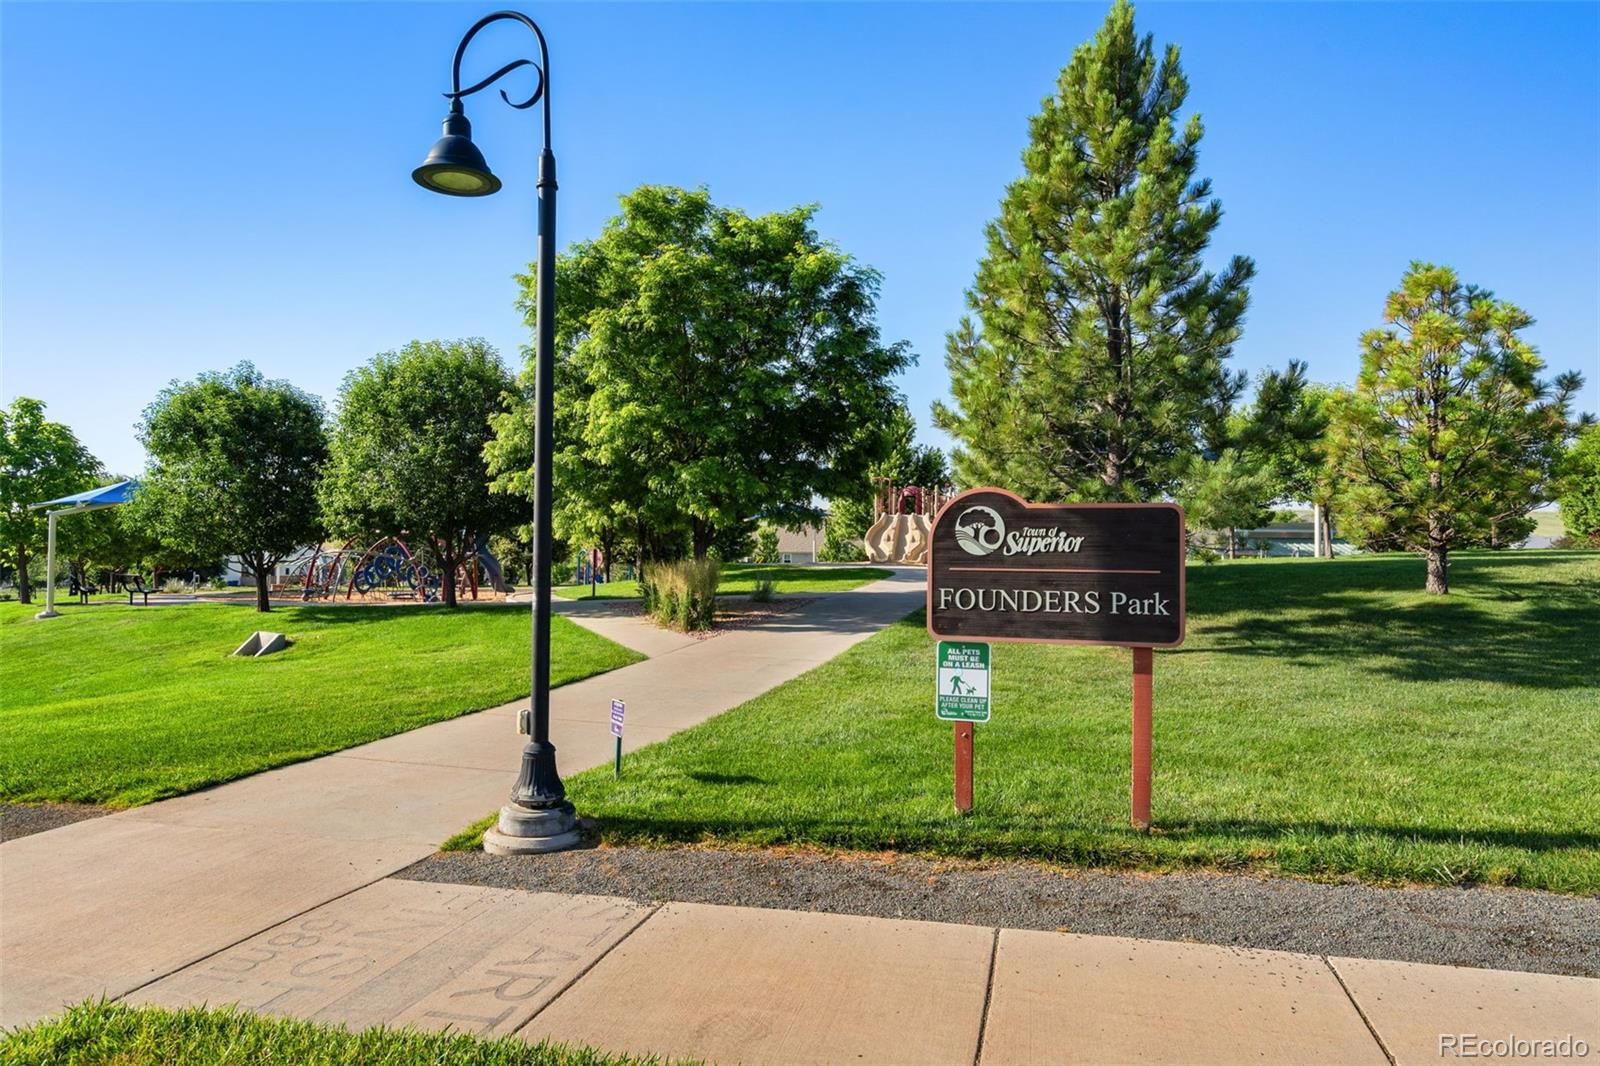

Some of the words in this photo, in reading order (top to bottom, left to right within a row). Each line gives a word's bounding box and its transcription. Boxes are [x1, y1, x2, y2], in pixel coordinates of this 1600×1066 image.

[1003, 530, 1085, 556] Superior
[1022, 526, 1046, 537] Town
[1048, 525, 1059, 538] of
[938, 587, 1101, 614] FOUNDERS
[1109, 591, 1171, 616] Park
